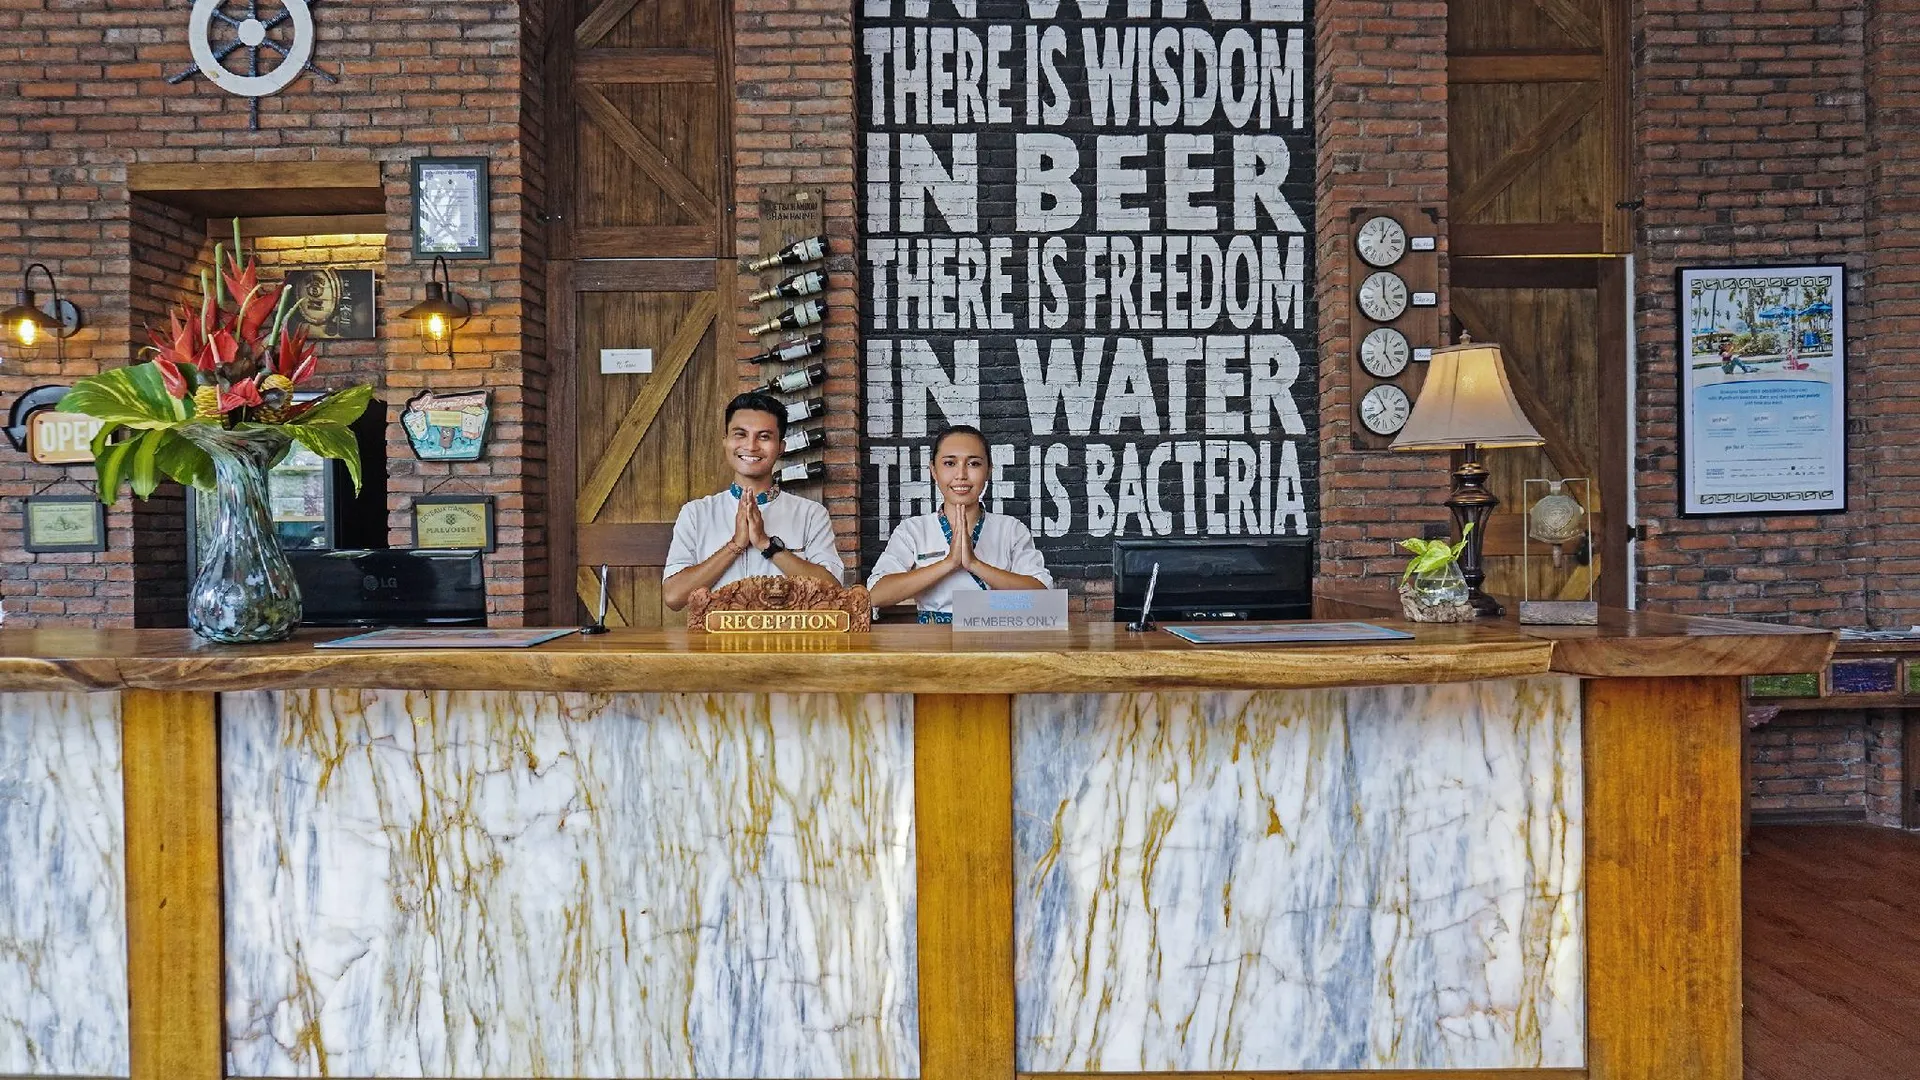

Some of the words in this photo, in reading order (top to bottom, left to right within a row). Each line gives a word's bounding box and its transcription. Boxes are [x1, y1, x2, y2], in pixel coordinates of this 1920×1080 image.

[863, 26, 1013, 126] THERE
[1025, 26, 1068, 126] IS
[1081, 27, 1304, 128] WISDOM
[866, 133, 978, 232] IN
[1015, 133, 1306, 232] BEER
[866, 237, 1014, 329] THERE
[1027, 236, 1069, 329] IS
[1084, 235, 1304, 330] FREEDOM
[866, 339, 981, 438] IN
[1015, 335, 1306, 436] WATER
[426, 526, 477, 534] MALVOISIE
[870, 441, 1015, 541] THE
[1029, 442, 1070, 537] IS
[1086, 440, 1308, 537] BACTERIA
[380, 577, 398, 589] LG
[719, 614, 839, 630] RECEPTION
[963, 616, 1023, 627] MEMBERS
[1026, 615, 1058, 627] ONLY
